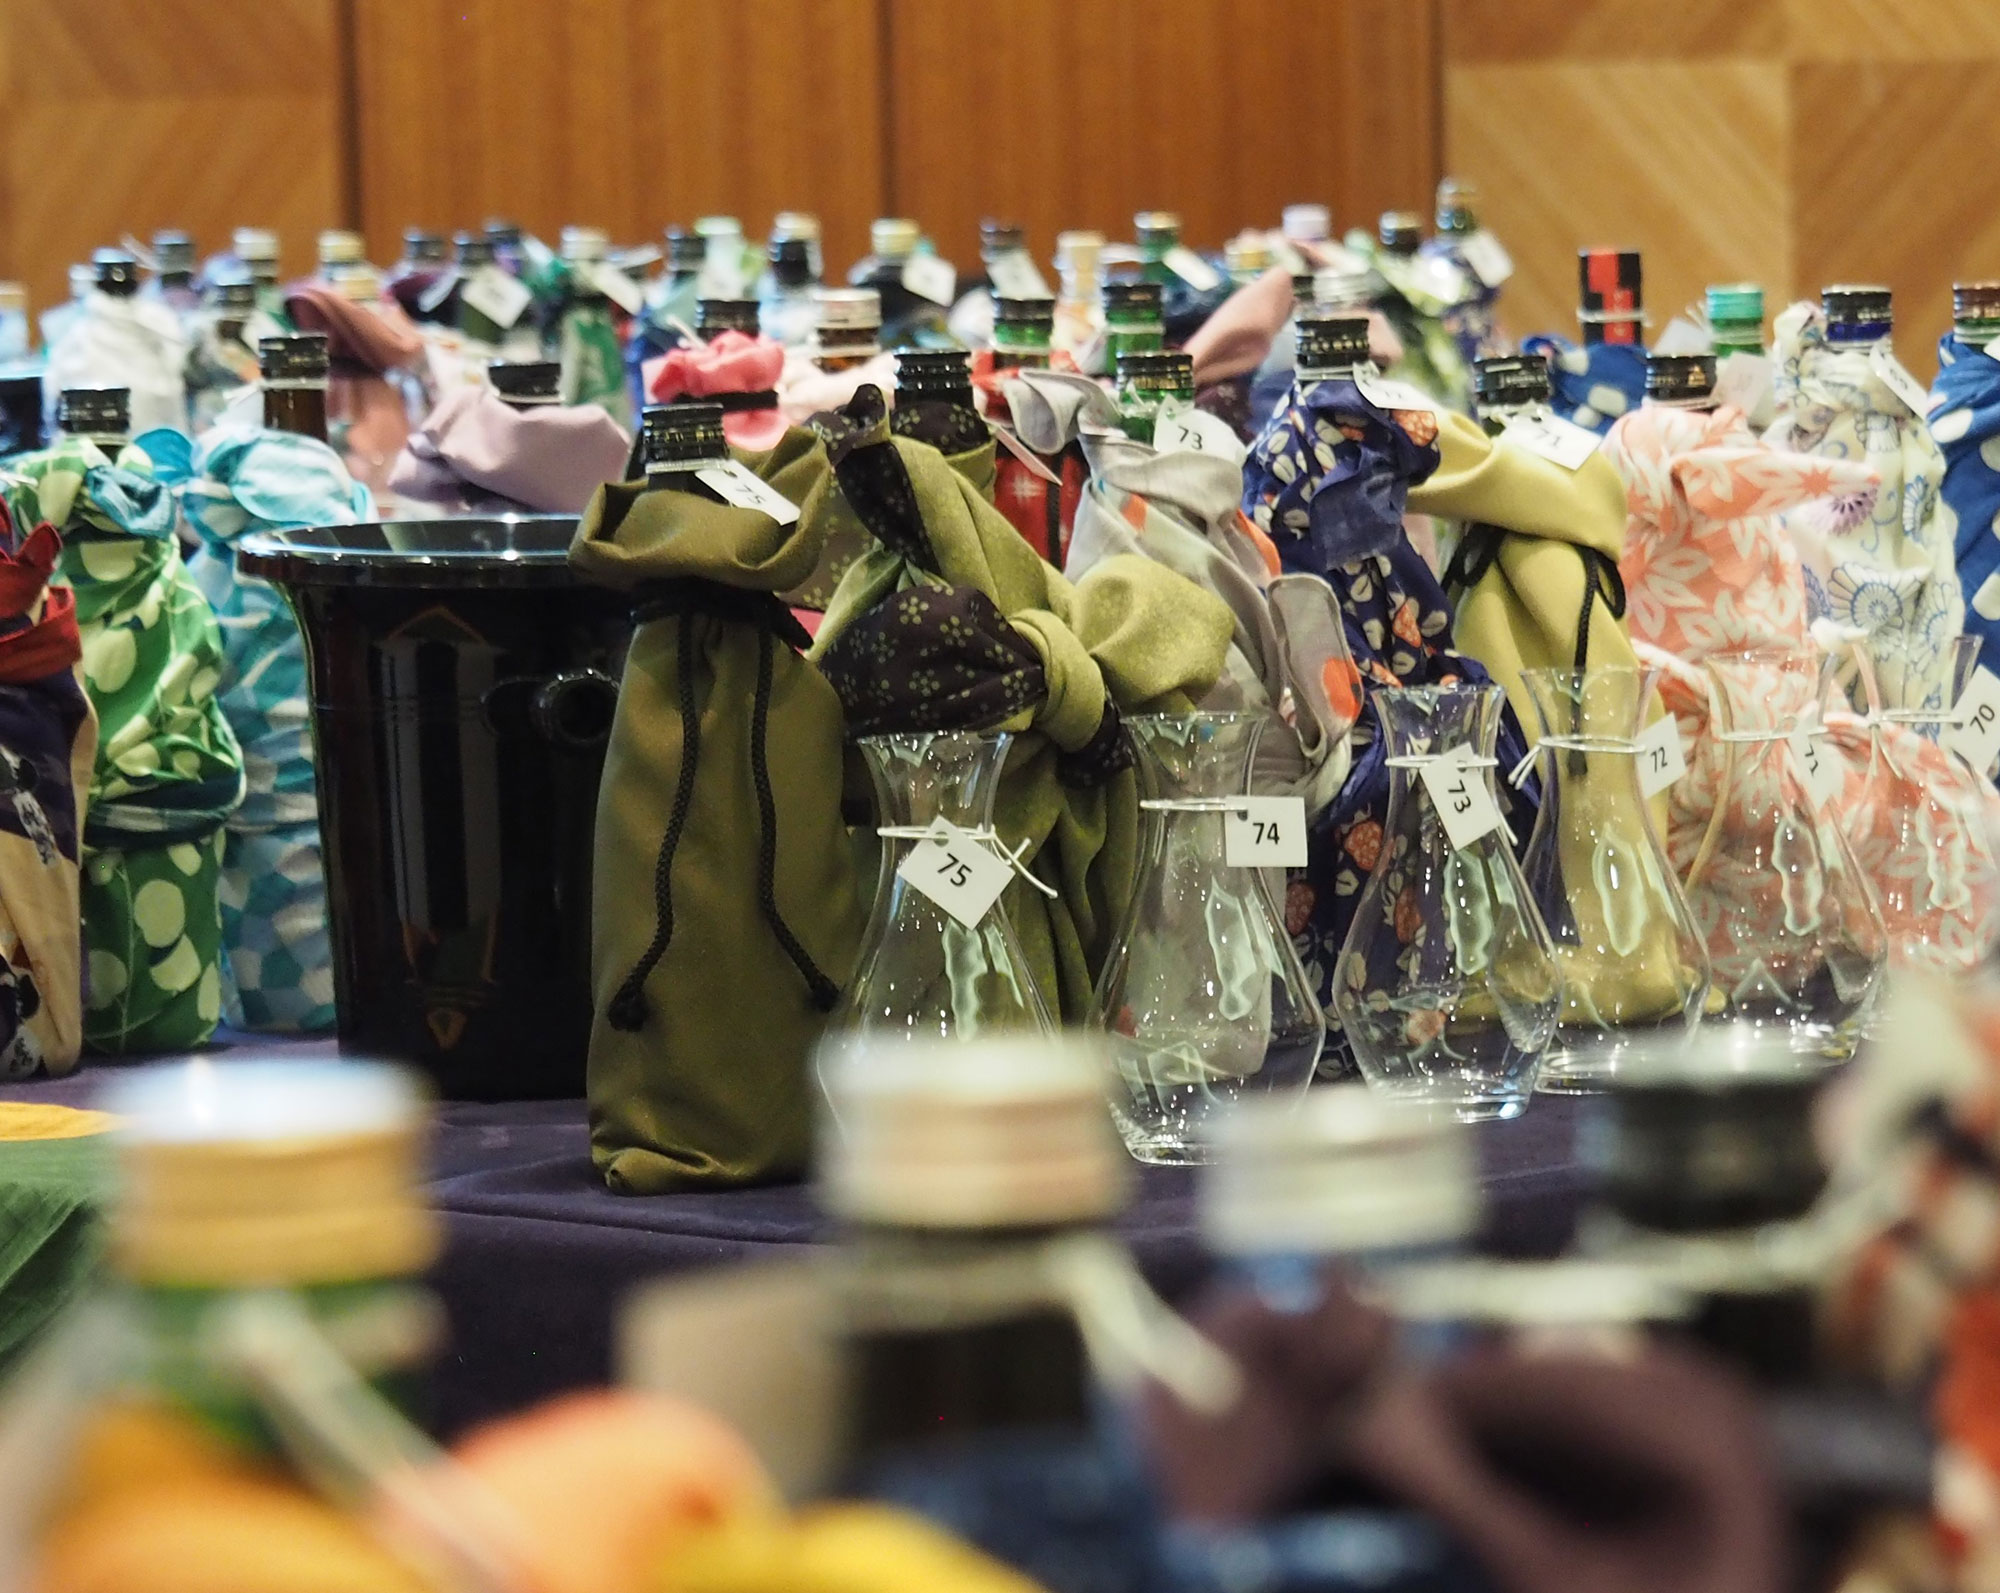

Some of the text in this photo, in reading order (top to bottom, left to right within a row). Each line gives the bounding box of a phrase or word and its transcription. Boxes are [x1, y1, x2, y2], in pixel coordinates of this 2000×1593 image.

[1178, 426, 1203, 450] 73
[735, 484, 766, 505] 75
[1969, 704, 1996, 735] 70
[1650, 747, 1668, 773] 72
[1448, 780, 1472, 813] 73
[1252, 823, 1280, 845] 74
[937, 853, 972, 887] 75
